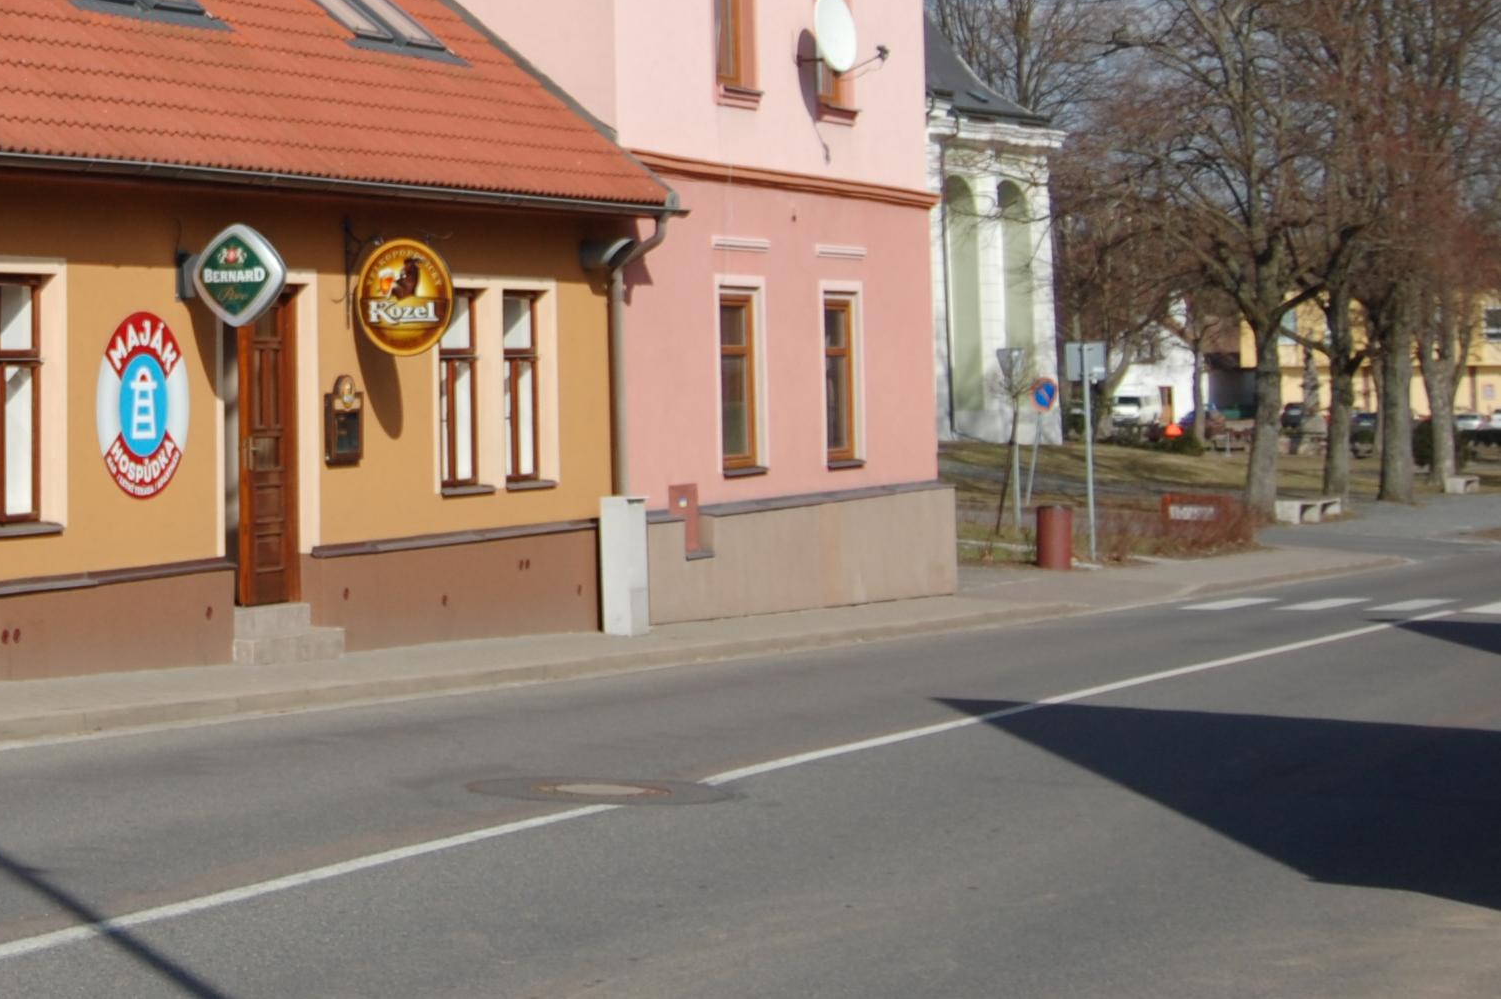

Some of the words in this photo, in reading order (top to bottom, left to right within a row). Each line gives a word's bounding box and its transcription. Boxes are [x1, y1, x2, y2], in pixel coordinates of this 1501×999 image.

[203, 266, 266, 283] BERNARD
[370, 300, 440, 325] Kozel
[109, 319, 177, 373] MAJÁK
